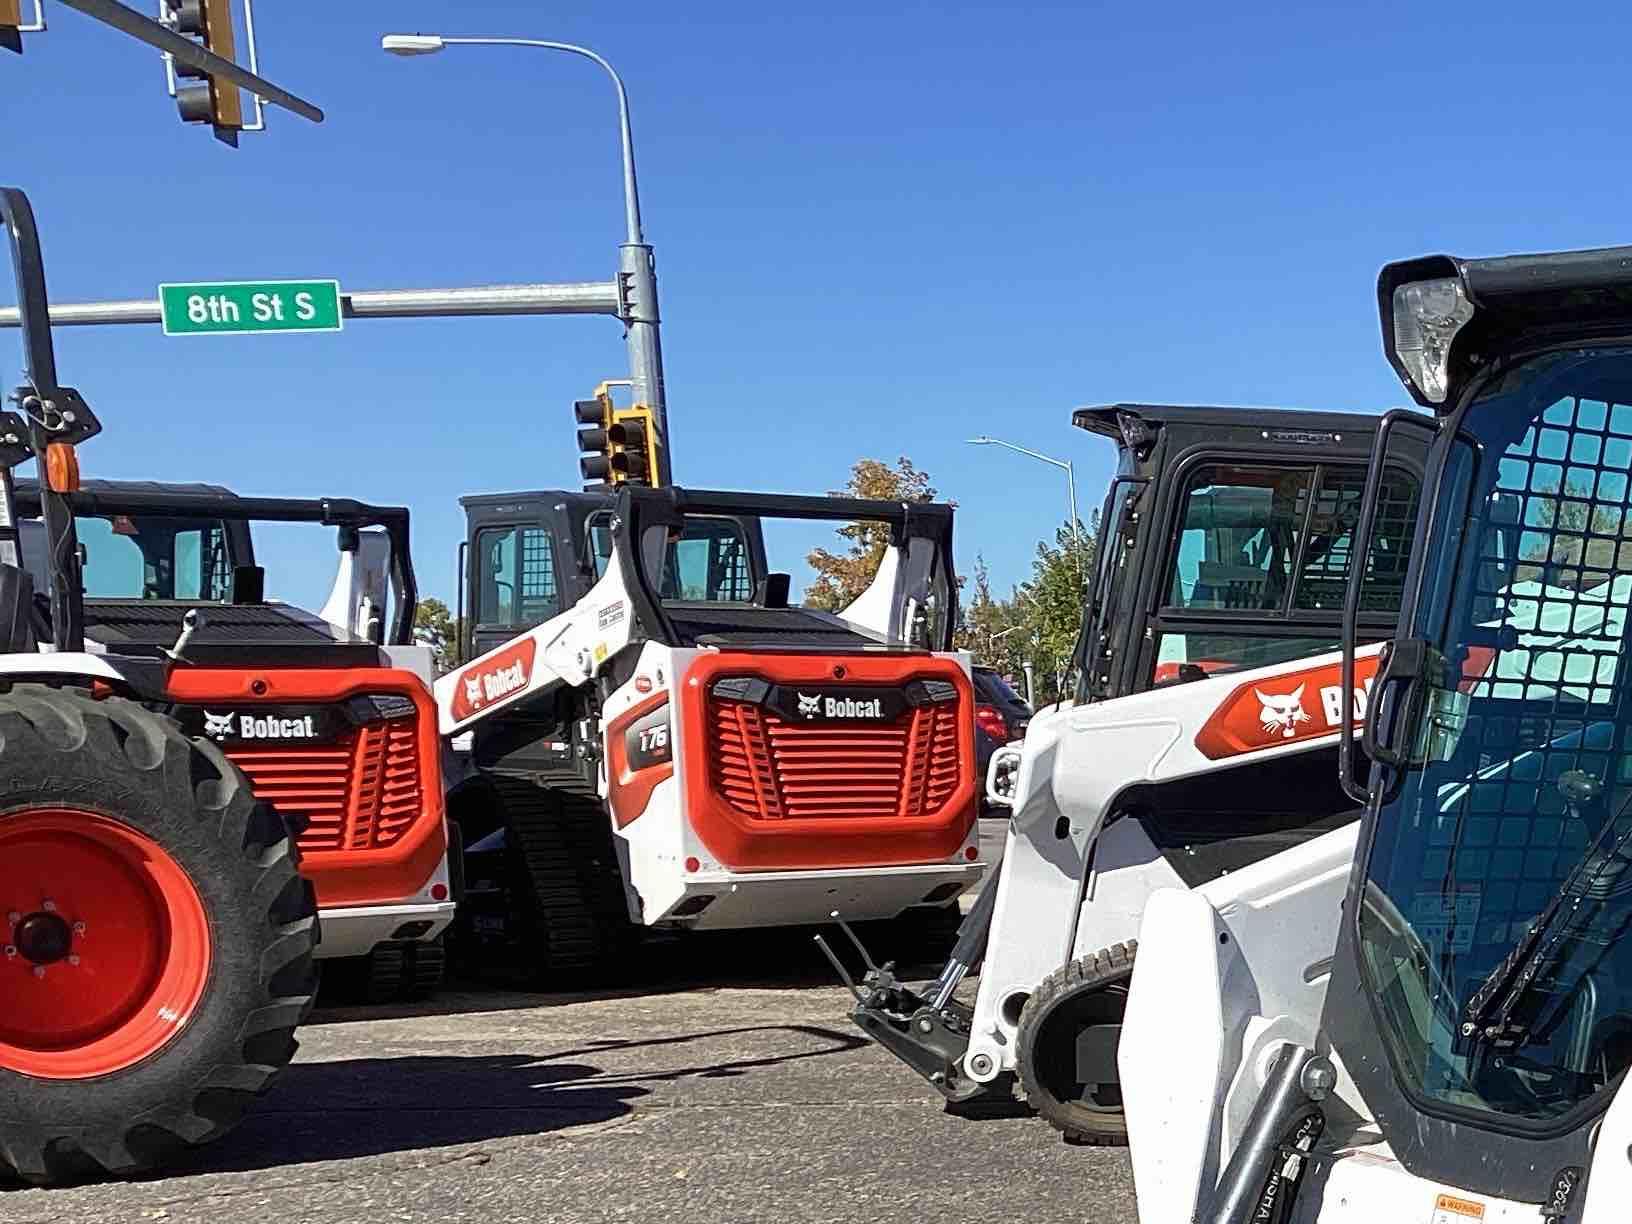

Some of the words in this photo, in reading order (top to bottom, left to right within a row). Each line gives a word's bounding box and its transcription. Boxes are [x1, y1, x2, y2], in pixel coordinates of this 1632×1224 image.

[188, 295, 240, 323] 8th
[252, 293, 284, 321] St
[295, 292, 316, 320] S
[483, 659, 527, 701] Bobcat
[825, 697, 882, 718] Bobcat
[240, 716, 314, 738] Bobcat
